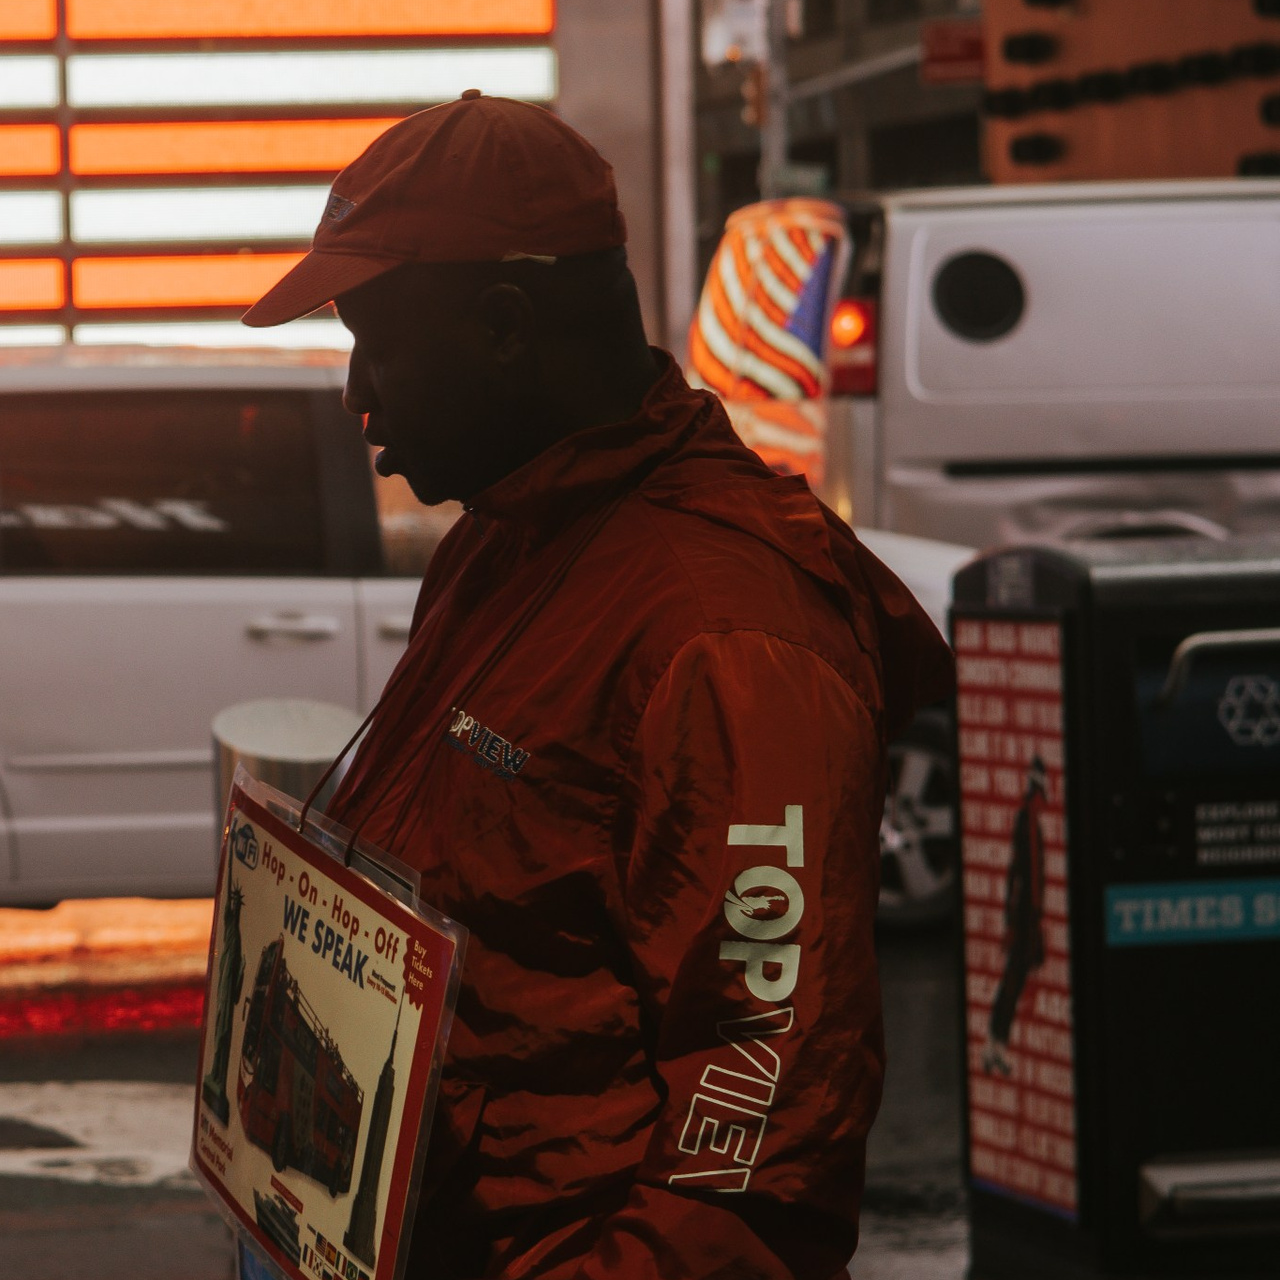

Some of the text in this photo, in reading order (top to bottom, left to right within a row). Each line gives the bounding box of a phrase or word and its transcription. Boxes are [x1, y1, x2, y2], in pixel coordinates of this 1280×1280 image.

[261, 841, 286, 886] Hop
[298, 871, 318, 906] On
[331, 894, 360, 940] Hop
[374, 926, 400, 964] Off
[1112, 894, 1244, 934] TIMES
[283, 894, 369, 990] WE SPEAK
[413, 939, 428, 957] Buy
[408, 972, 424, 992] Here
[410, 956, 433, 979] Tickets
[669, 804, 805, 1193] TOPVIE
